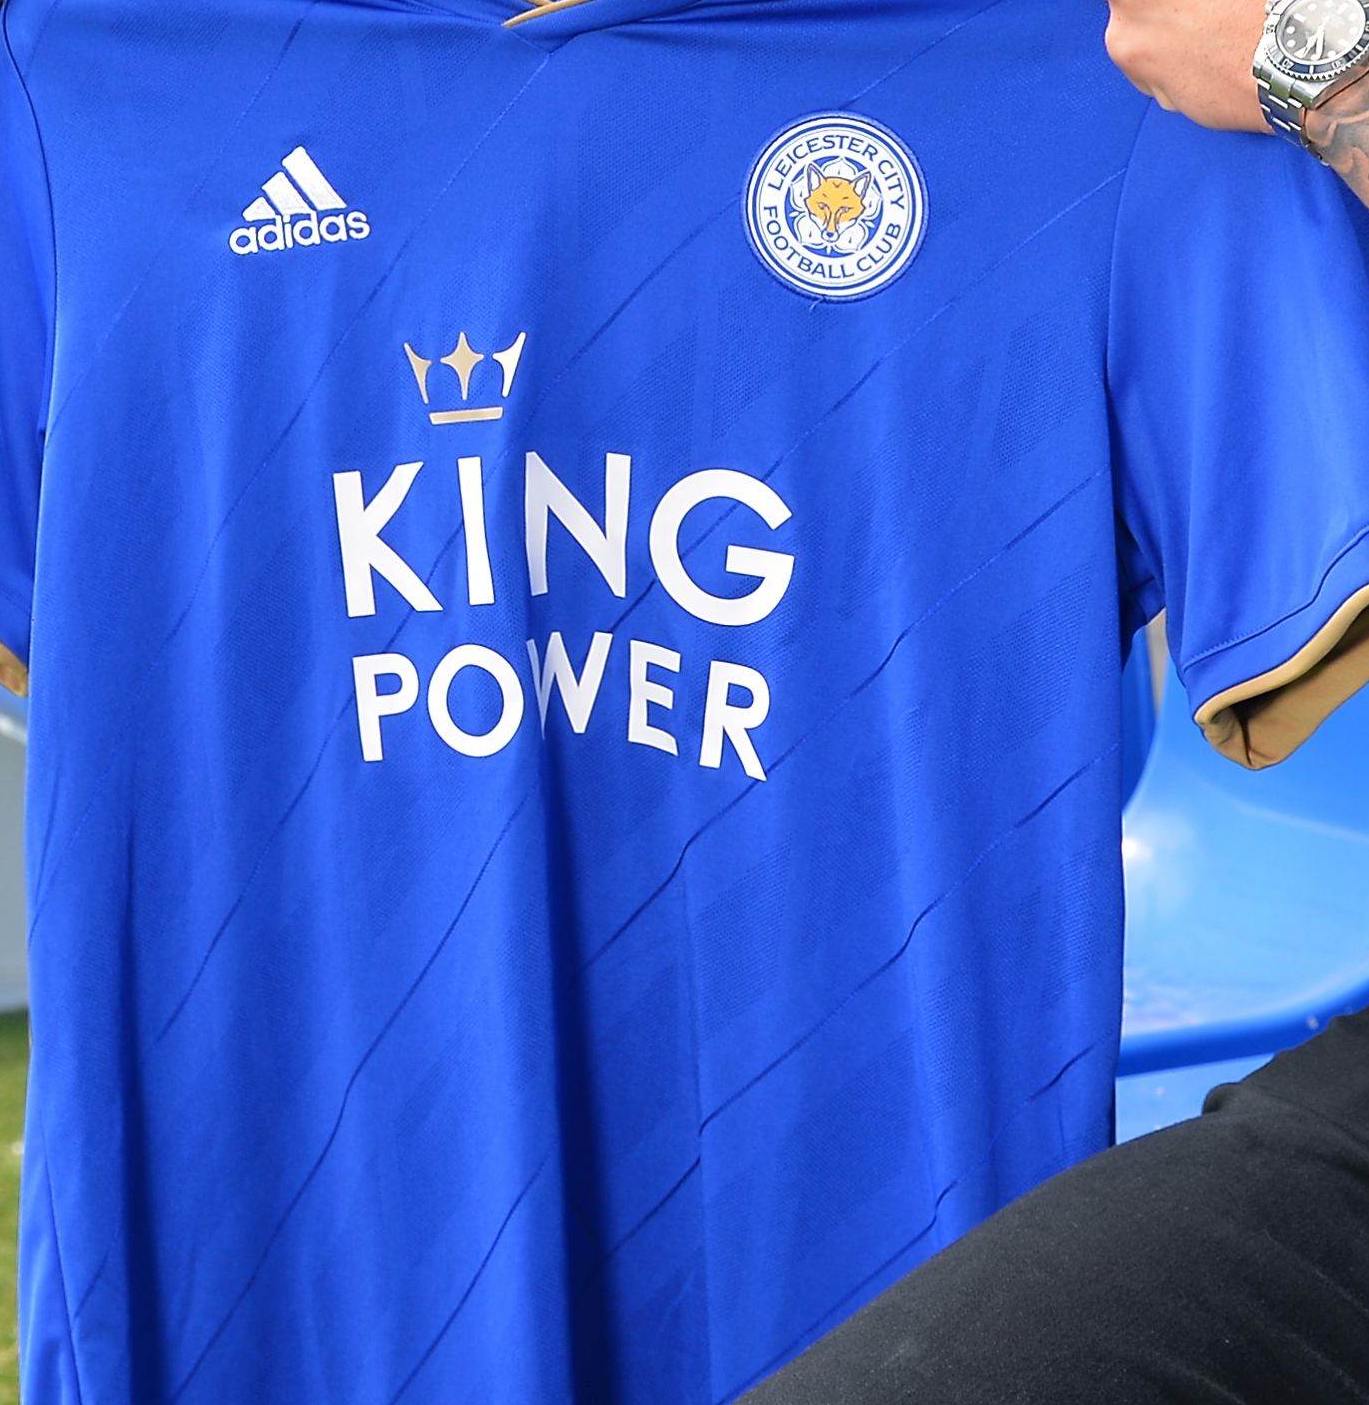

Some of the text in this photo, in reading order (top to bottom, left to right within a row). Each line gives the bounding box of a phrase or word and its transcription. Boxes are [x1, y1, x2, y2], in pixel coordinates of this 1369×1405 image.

[767, 134, 905, 210] LEICESTER CITY
[228, 209, 371, 255] adidas
[763, 205, 902, 279] FOOTBALL CLUB
[332, 451, 795, 626] KING
[352, 631, 770, 782] POWER
